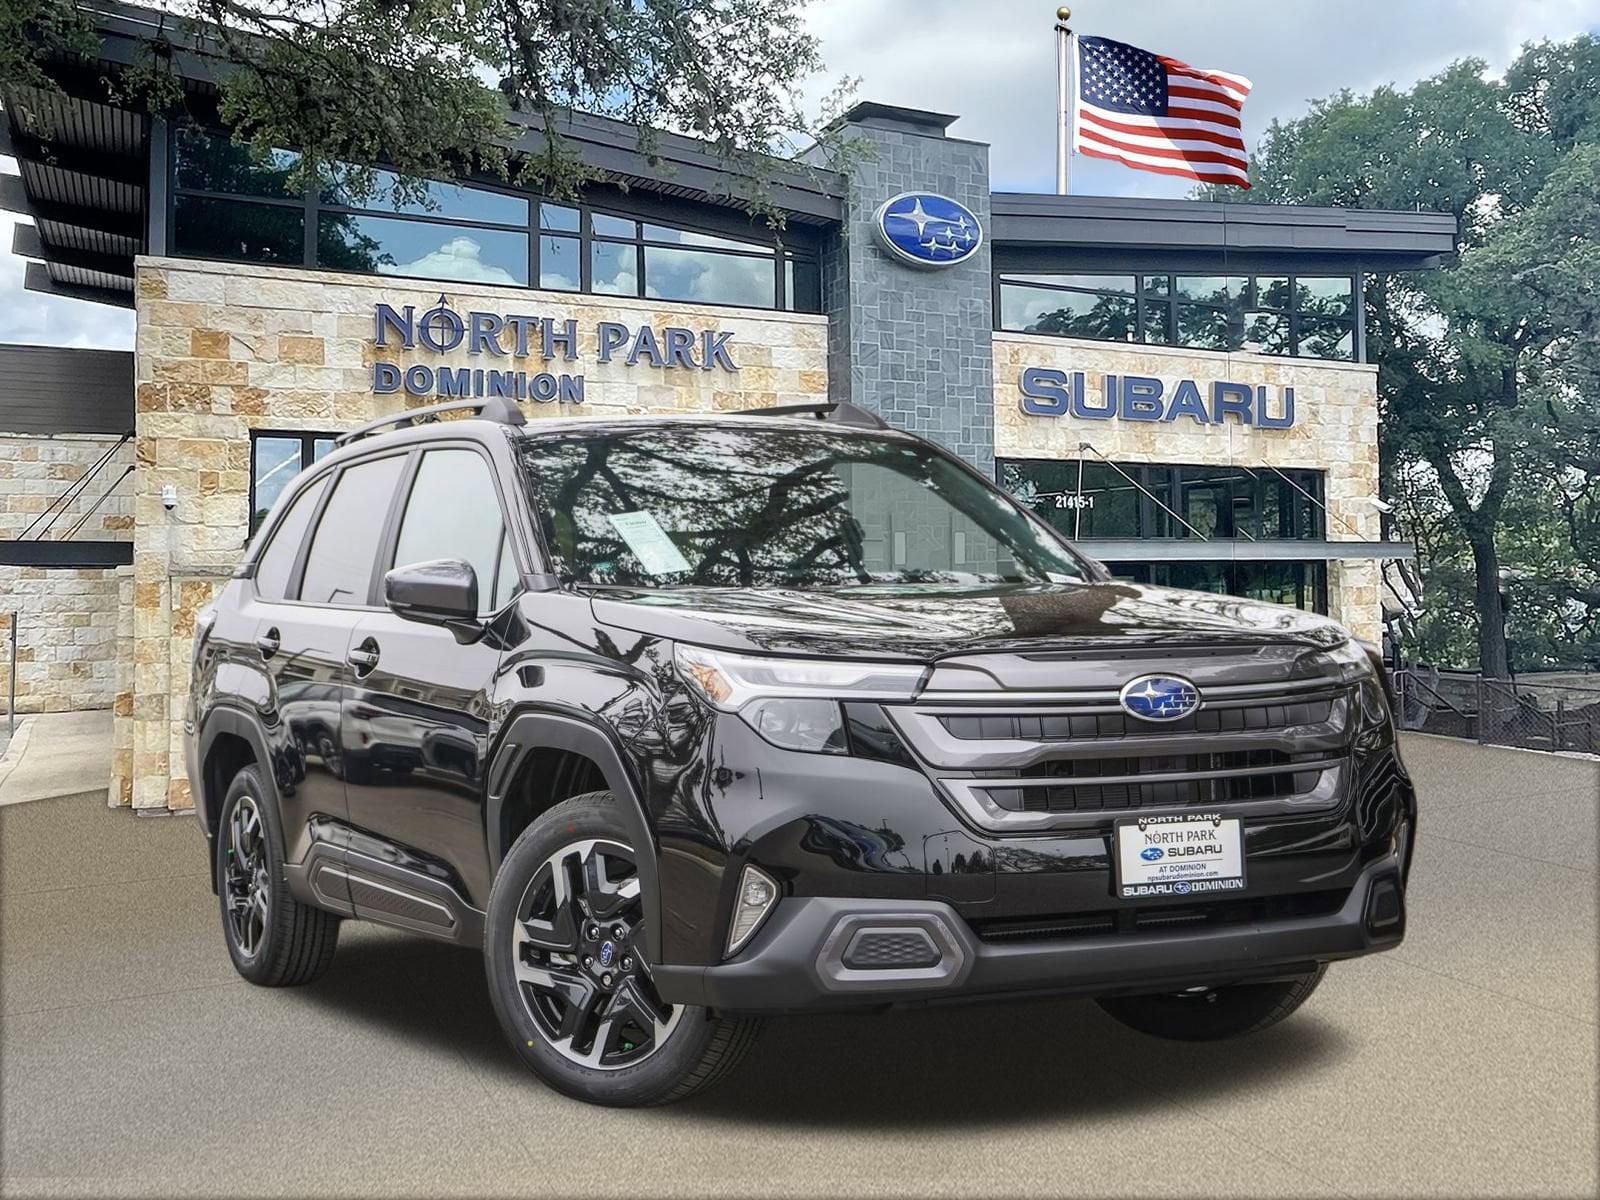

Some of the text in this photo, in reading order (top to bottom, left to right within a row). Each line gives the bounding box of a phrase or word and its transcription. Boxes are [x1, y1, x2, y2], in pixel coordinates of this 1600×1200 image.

[374, 293, 742, 373] NORTH PARK
[373, 361, 585, 403] DOMINION
[1019, 366, 1296, 430] SUBARU
[1055, 495, 1094, 509] 21415-1
[1138, 813, 1221, 825] NORTH PARK
[1144, 829, 1217, 845] NORTH PARK
[1167, 844, 1223, 858] SUBARU
[1159, 863, 1206, 873] AT DOMINION
[1147, 871, 1218, 882] npsubarudominion.com
[1122, 878, 1244, 897] SUBARU DOMINION
